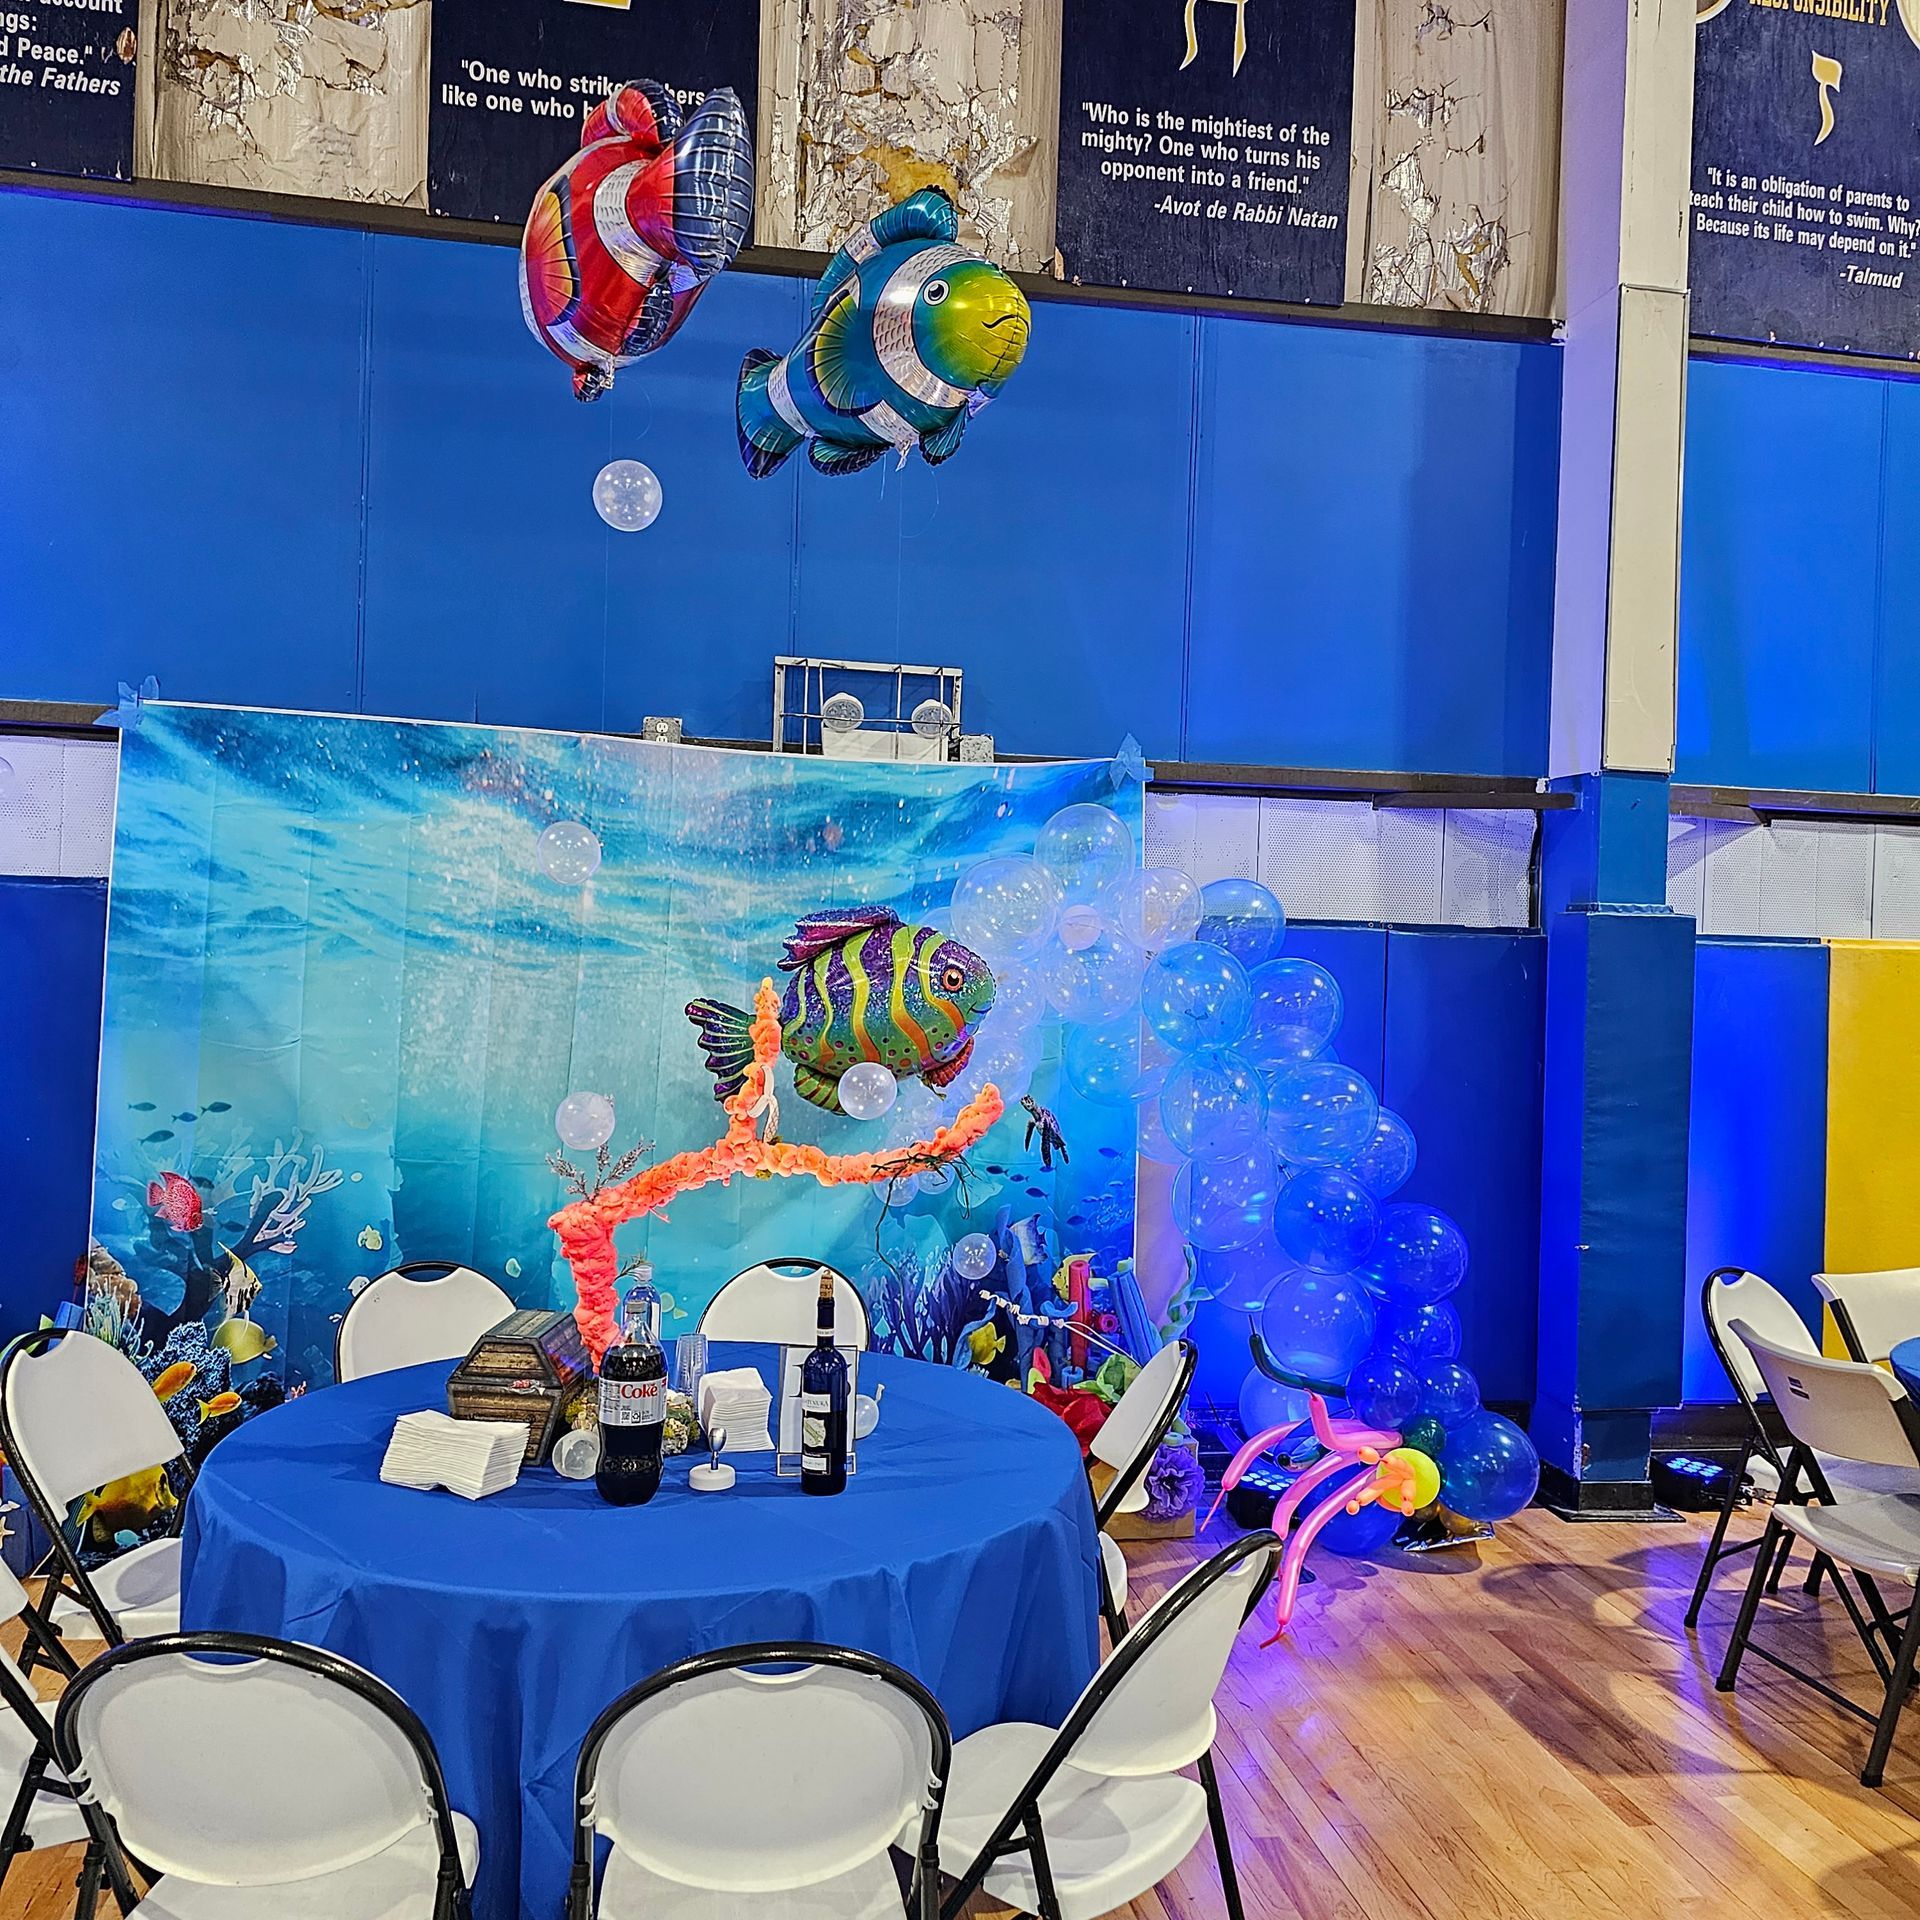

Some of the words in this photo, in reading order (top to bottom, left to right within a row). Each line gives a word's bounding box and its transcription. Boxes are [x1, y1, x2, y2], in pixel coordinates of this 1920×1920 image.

[17, 37, 93, 65] Peace."
[0, 62, 33, 85] the
[40, 66, 121, 96] Fathers
[461, 59, 510, 84] "One
[518, 68, 562, 91] who
[442, 83, 477, 107] like
[485, 94, 523, 113] one
[531, 96, 575, 119] who
[1082, 102, 1129, 125] "Who
[1136, 107, 1150, 127] is
[1156, 111, 1185, 131] the
[1191, 115, 1273, 140] mightiest
[1279, 124, 1297, 142] of
[1302, 126, 1330, 146] the
[1081, 128, 1152, 156] mighty?
[1159, 135, 1194, 157] One
[1200, 141, 1238, 161] who
[1245, 146, 1290, 167] turns
[1296, 149, 1320, 169] his
[1101, 161, 1185, 183] opponent
[1191, 164, 1225, 186] into
[1231, 174, 1241, 188] a
[1248, 170, 1309, 194] friend."
[1707, 166, 1722, 186] "It
[1726, 169, 1737, 187] is
[1741, 176, 1757, 190] an
[1761, 175, 1825, 200] obligation
[1829, 184, 1843, 202] of
[1846, 190, 1892, 209] parents
[1896, 194, 1909, 212] to
[1154, 195, 1201, 217] -Avot
[1206, 200, 1227, 219] de
[1232, 202, 1283, 224] Rabbi
[1287, 207, 1338, 229] Natan
[1690, 190, 1723, 209] teach
[1727, 193, 1758, 214] their
[1762, 198, 1793, 218] child
[1797, 202, 1825, 222] how
[1829, 208, 1843, 226] to
[1846, 211, 1883, 231] swim.
[1887, 214, 1920, 240] Why?
[1696, 212, 1749, 237] Because
[1753, 220, 1770, 239] its
[1773, 222, 1793, 242] life
[1797, 230, 1825, 250] may
[1829, 231, 1875, 254] depend
[1879, 241, 1894, 256] on
[1898, 239, 1916, 259] it."
[1839, 264, 1903, 289] -Talmud
[621, 1383, 658, 1399] Coke
